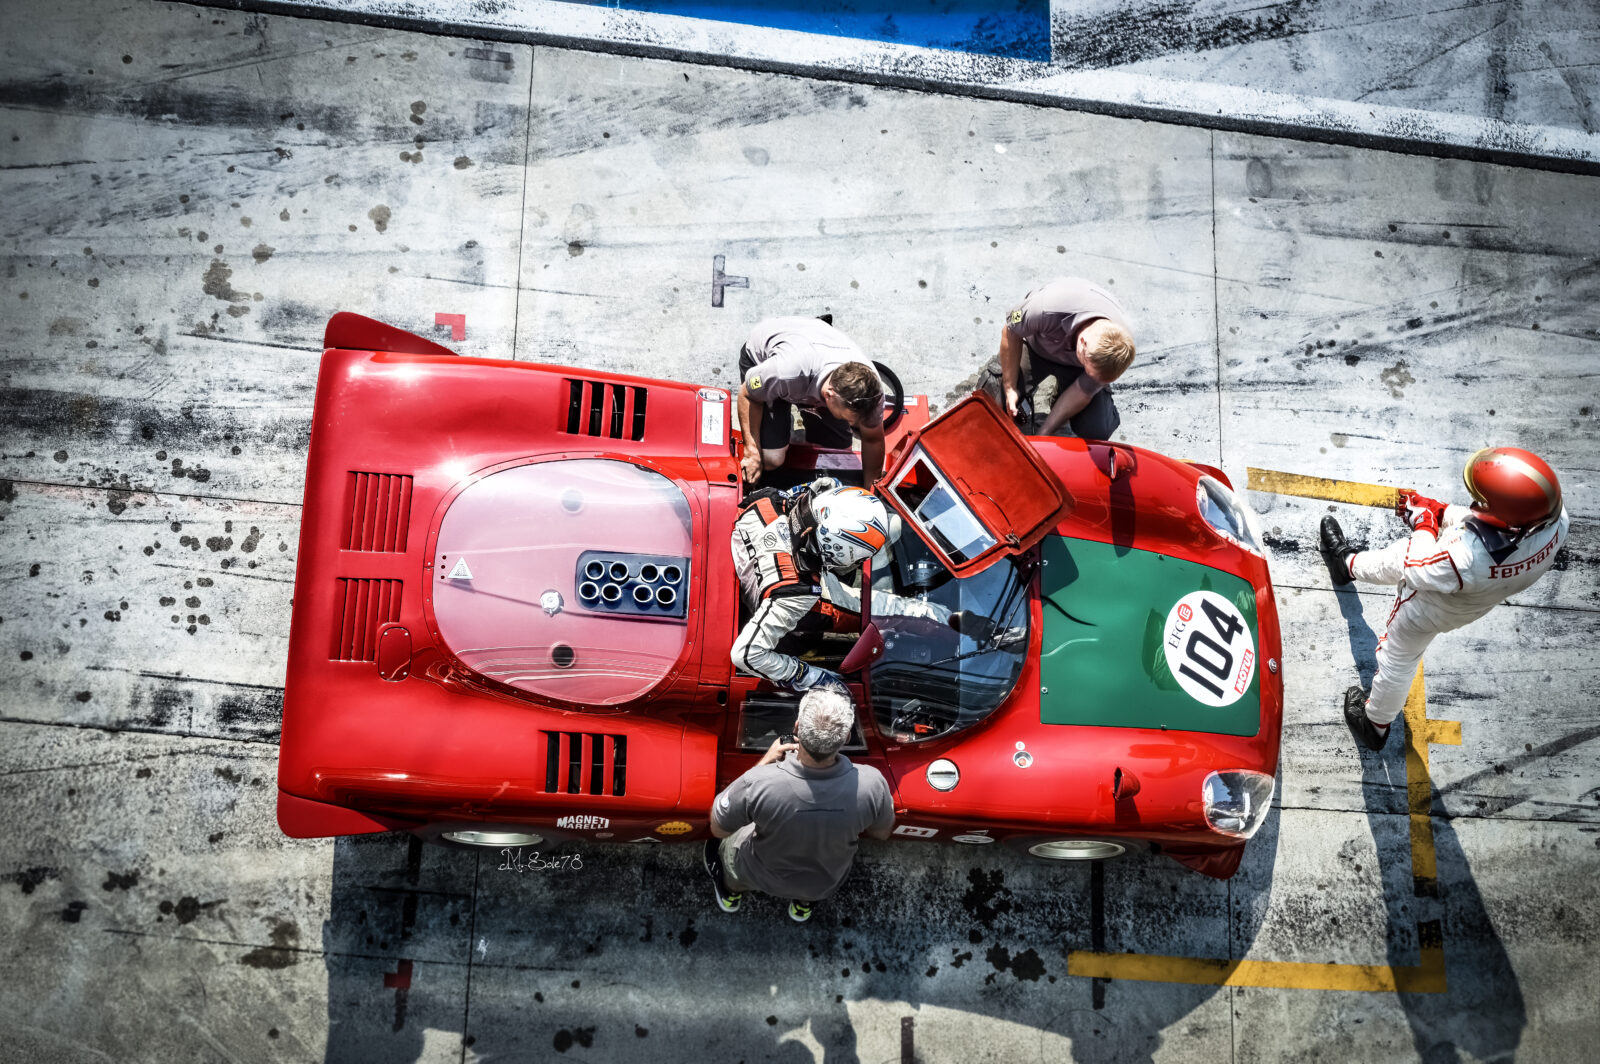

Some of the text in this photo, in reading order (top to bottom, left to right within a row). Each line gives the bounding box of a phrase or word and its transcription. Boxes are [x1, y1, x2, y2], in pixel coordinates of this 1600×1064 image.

[1488, 530, 1559, 579] Ferrari
[1169, 620, 1186, 648] EFG
[1179, 599, 1244, 699] 104
[1235, 650, 1254, 694] MOTUL
[557, 815, 609, 827] MAGNETI
[904, 828, 929, 836] P1
